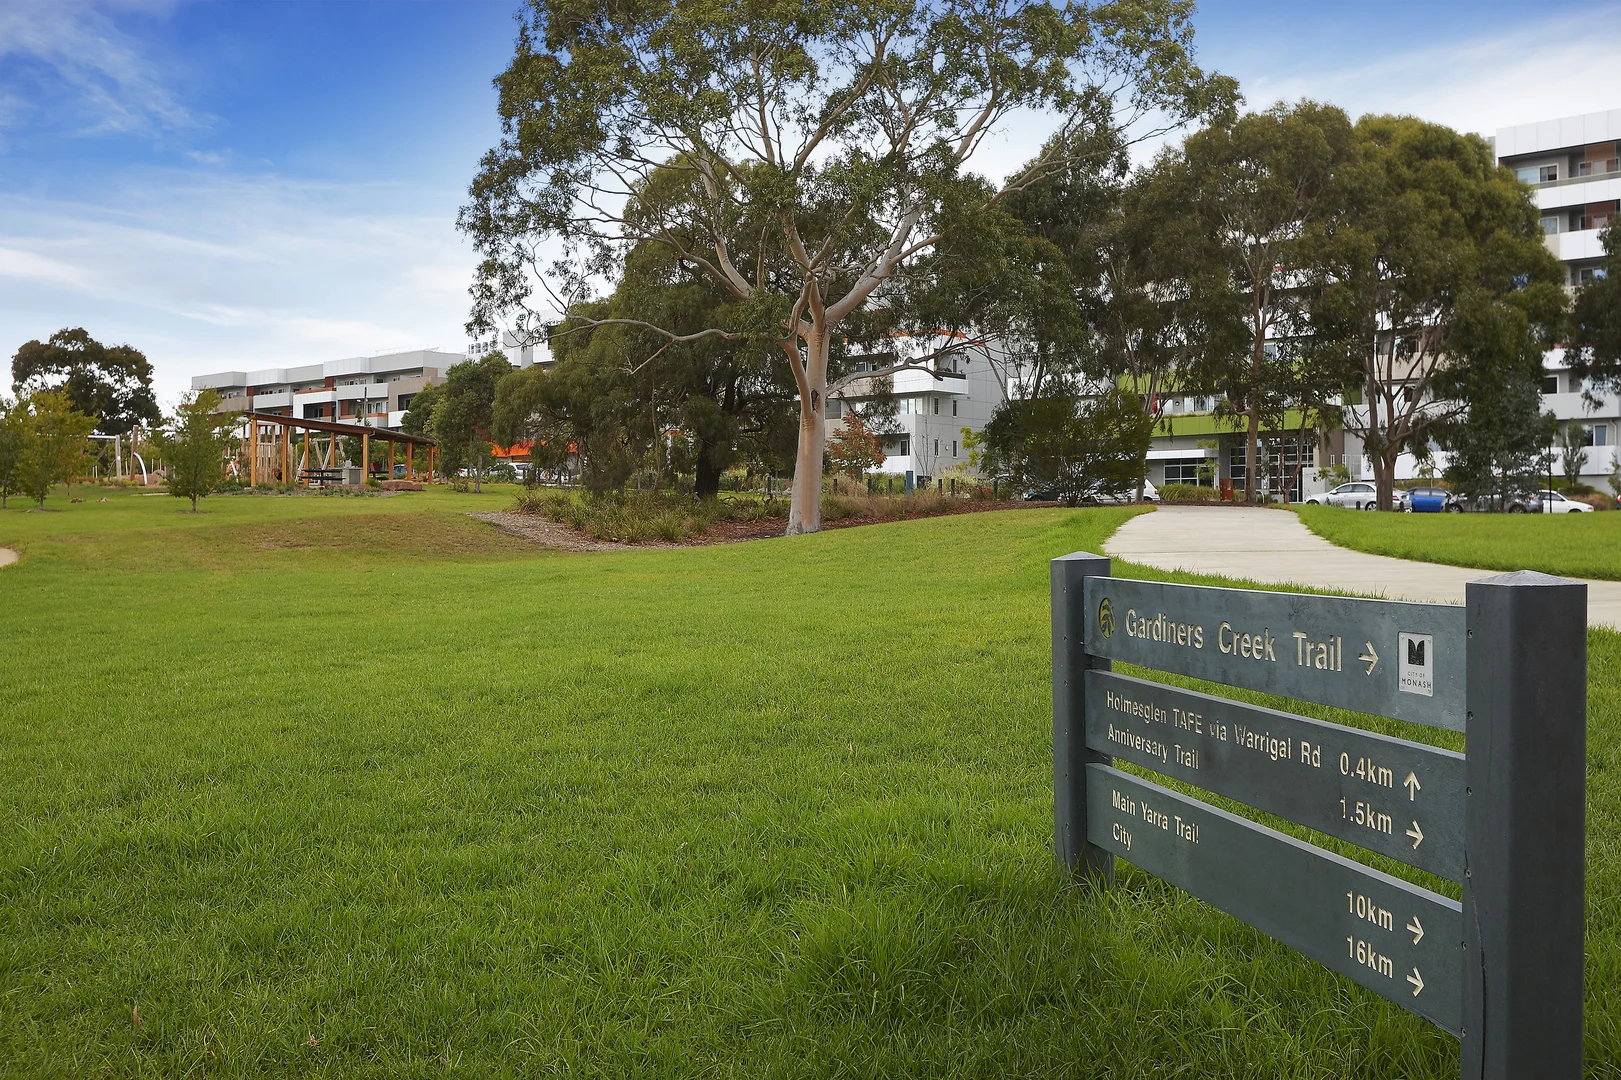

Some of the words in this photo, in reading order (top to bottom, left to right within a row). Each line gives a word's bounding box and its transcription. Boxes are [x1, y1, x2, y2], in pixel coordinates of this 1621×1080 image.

[1125, 608, 1204, 649] Gardiners
[1218, 621, 1276, 662] Creek
[1293, 631, 1342, 672] Trail
[1401, 678, 1432, 689] MONASH
[1106, 691, 1167, 724] Holmesglen
[1173, 708, 1202, 735] TAFE
[1210, 720, 1227, 742] via
[1234, 723, 1292, 762] Warrigal
[1301, 741, 1321, 769] Rd
[1339, 752, 1393, 788] 0.4km
[1107, 723, 1168, 764] Anniversary
[1174, 745, 1199, 770] Trail
[1112, 789, 1136, 817] Main
[1141, 801, 1168, 831] Yarra
[1174, 815, 1200, 844] Trail
[1112, 822, 1132, 851] City
[1339, 796, 1393, 835] 1.5km
[1346, 890, 1393, 932] 10km
[1346, 936, 1393, 979] 16km
